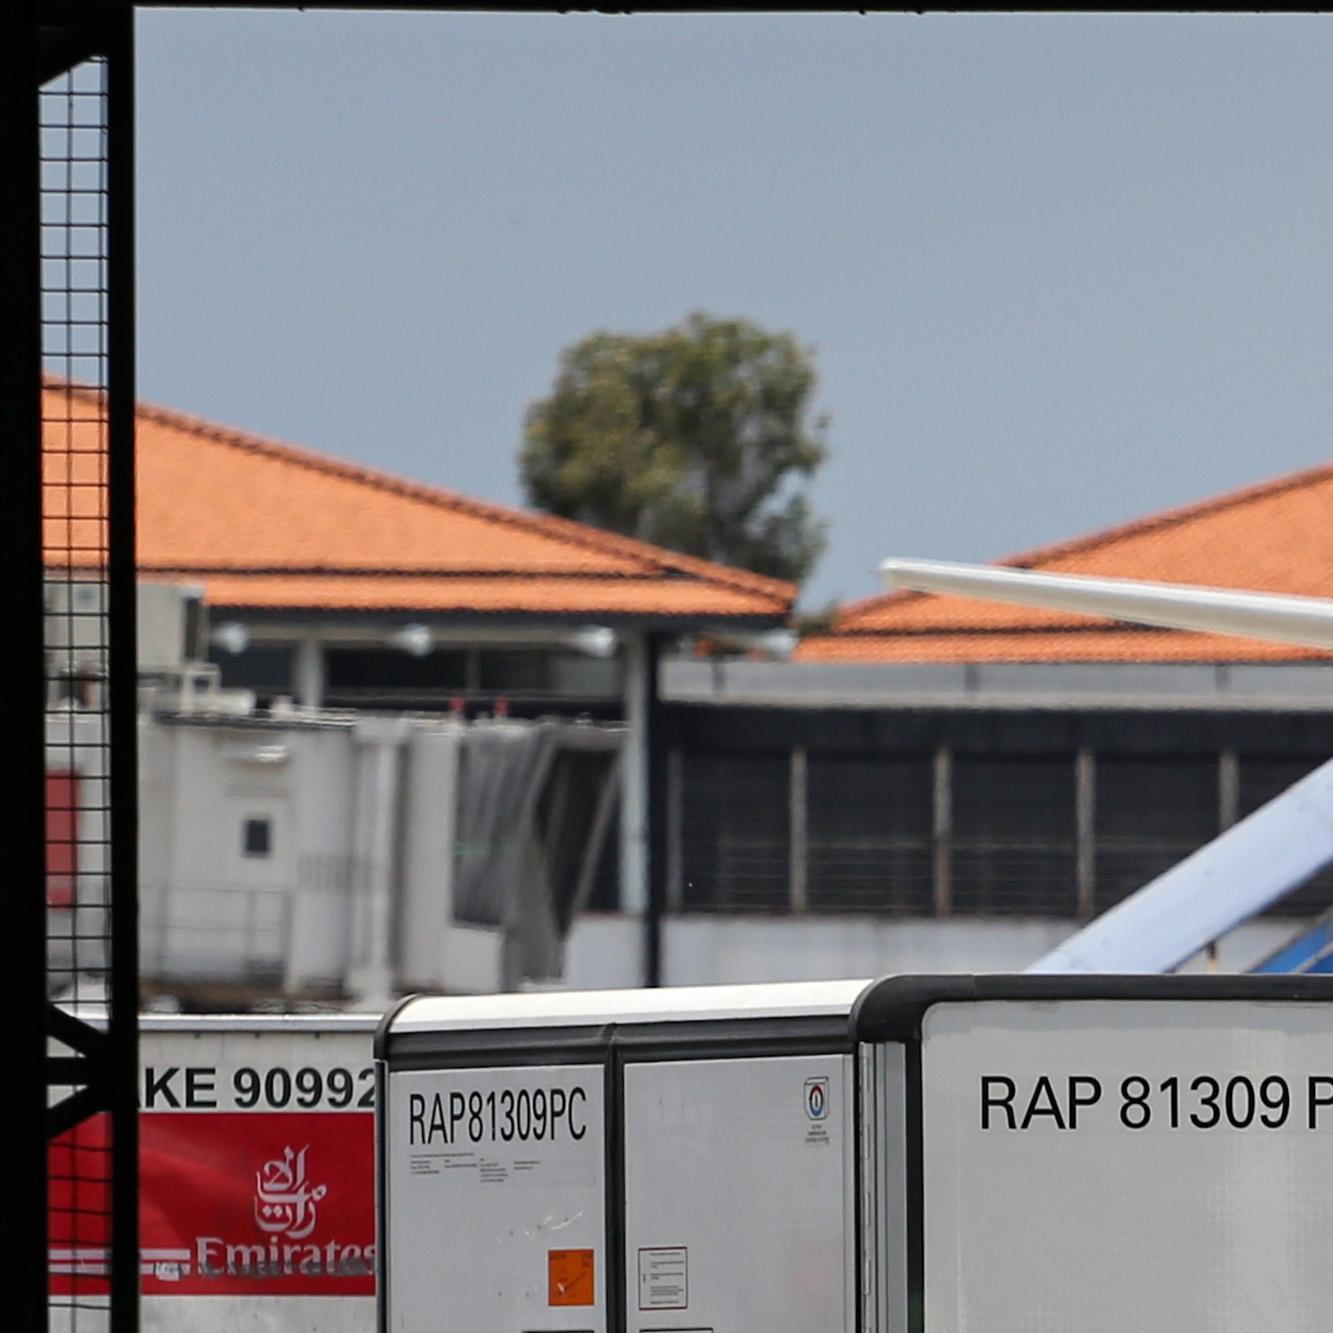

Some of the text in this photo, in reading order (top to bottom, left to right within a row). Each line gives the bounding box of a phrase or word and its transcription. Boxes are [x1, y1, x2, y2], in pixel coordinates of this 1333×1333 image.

[139, 1067, 217, 1109] KE
[980, 1075, 1102, 1131] RAP
[1119, 1075, 1291, 1131] 81309
[409, 1086, 587, 1146] RAP81309PC
[195, 1236, 377, 1276] Emirates
